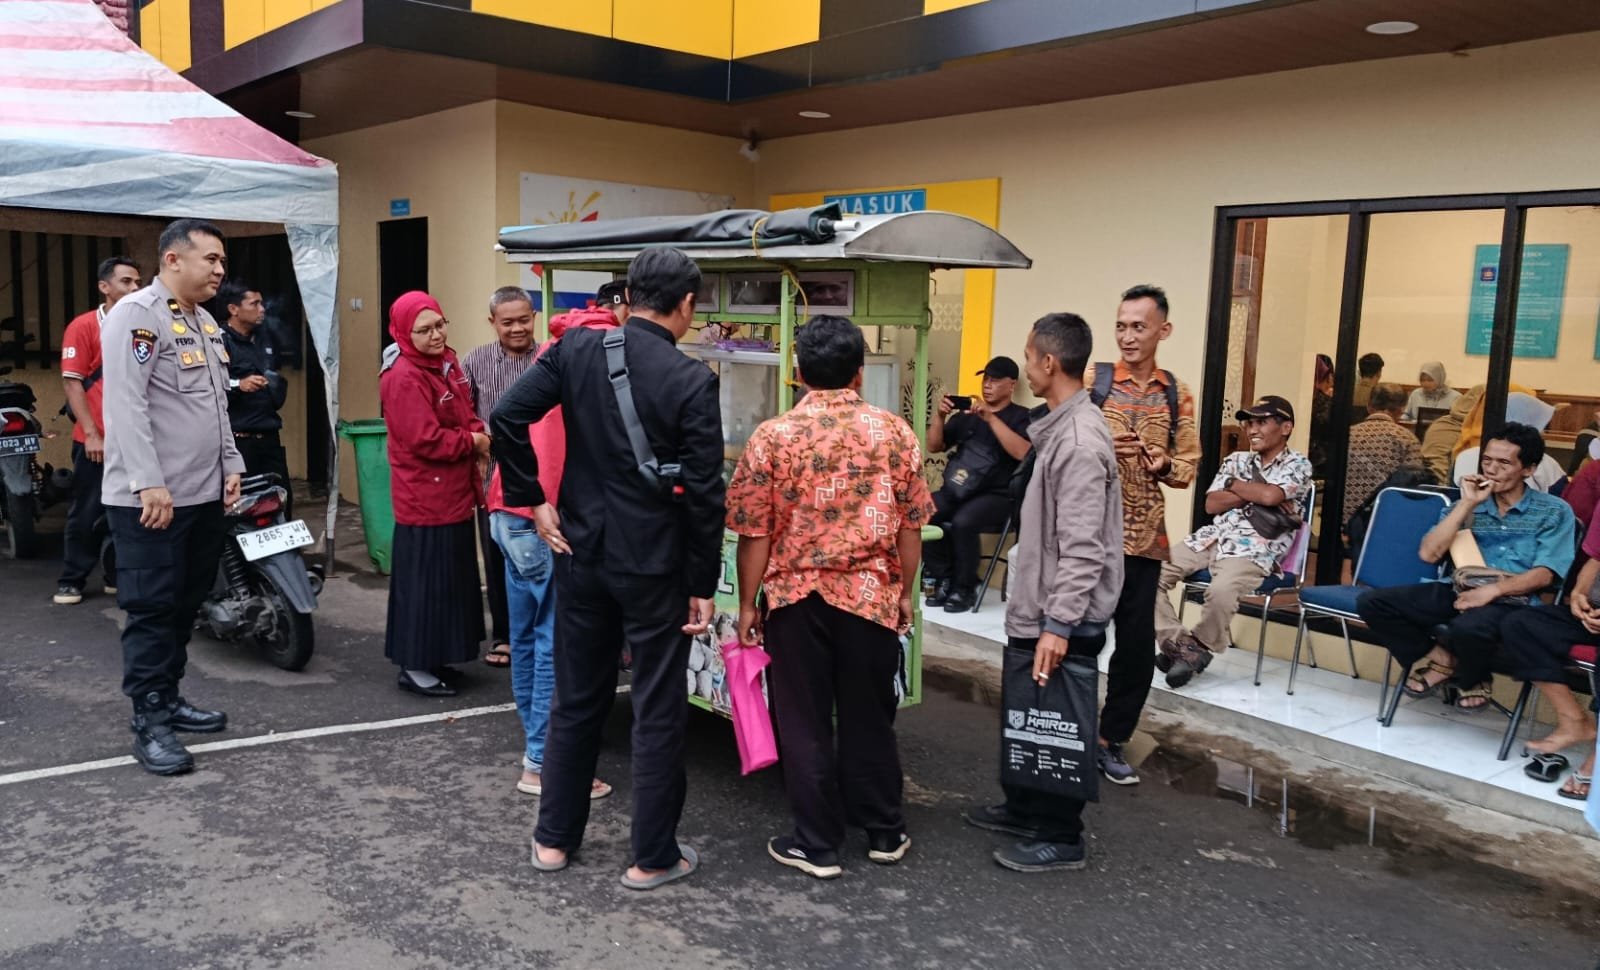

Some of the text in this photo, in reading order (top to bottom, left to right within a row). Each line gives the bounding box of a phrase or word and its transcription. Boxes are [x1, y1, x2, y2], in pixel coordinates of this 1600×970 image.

[836, 194, 913, 214] MASUK
[240, 536, 249, 548] R
[255, 528, 283, 545] 2865
[1027, 716, 1079, 734] KAIROZ
